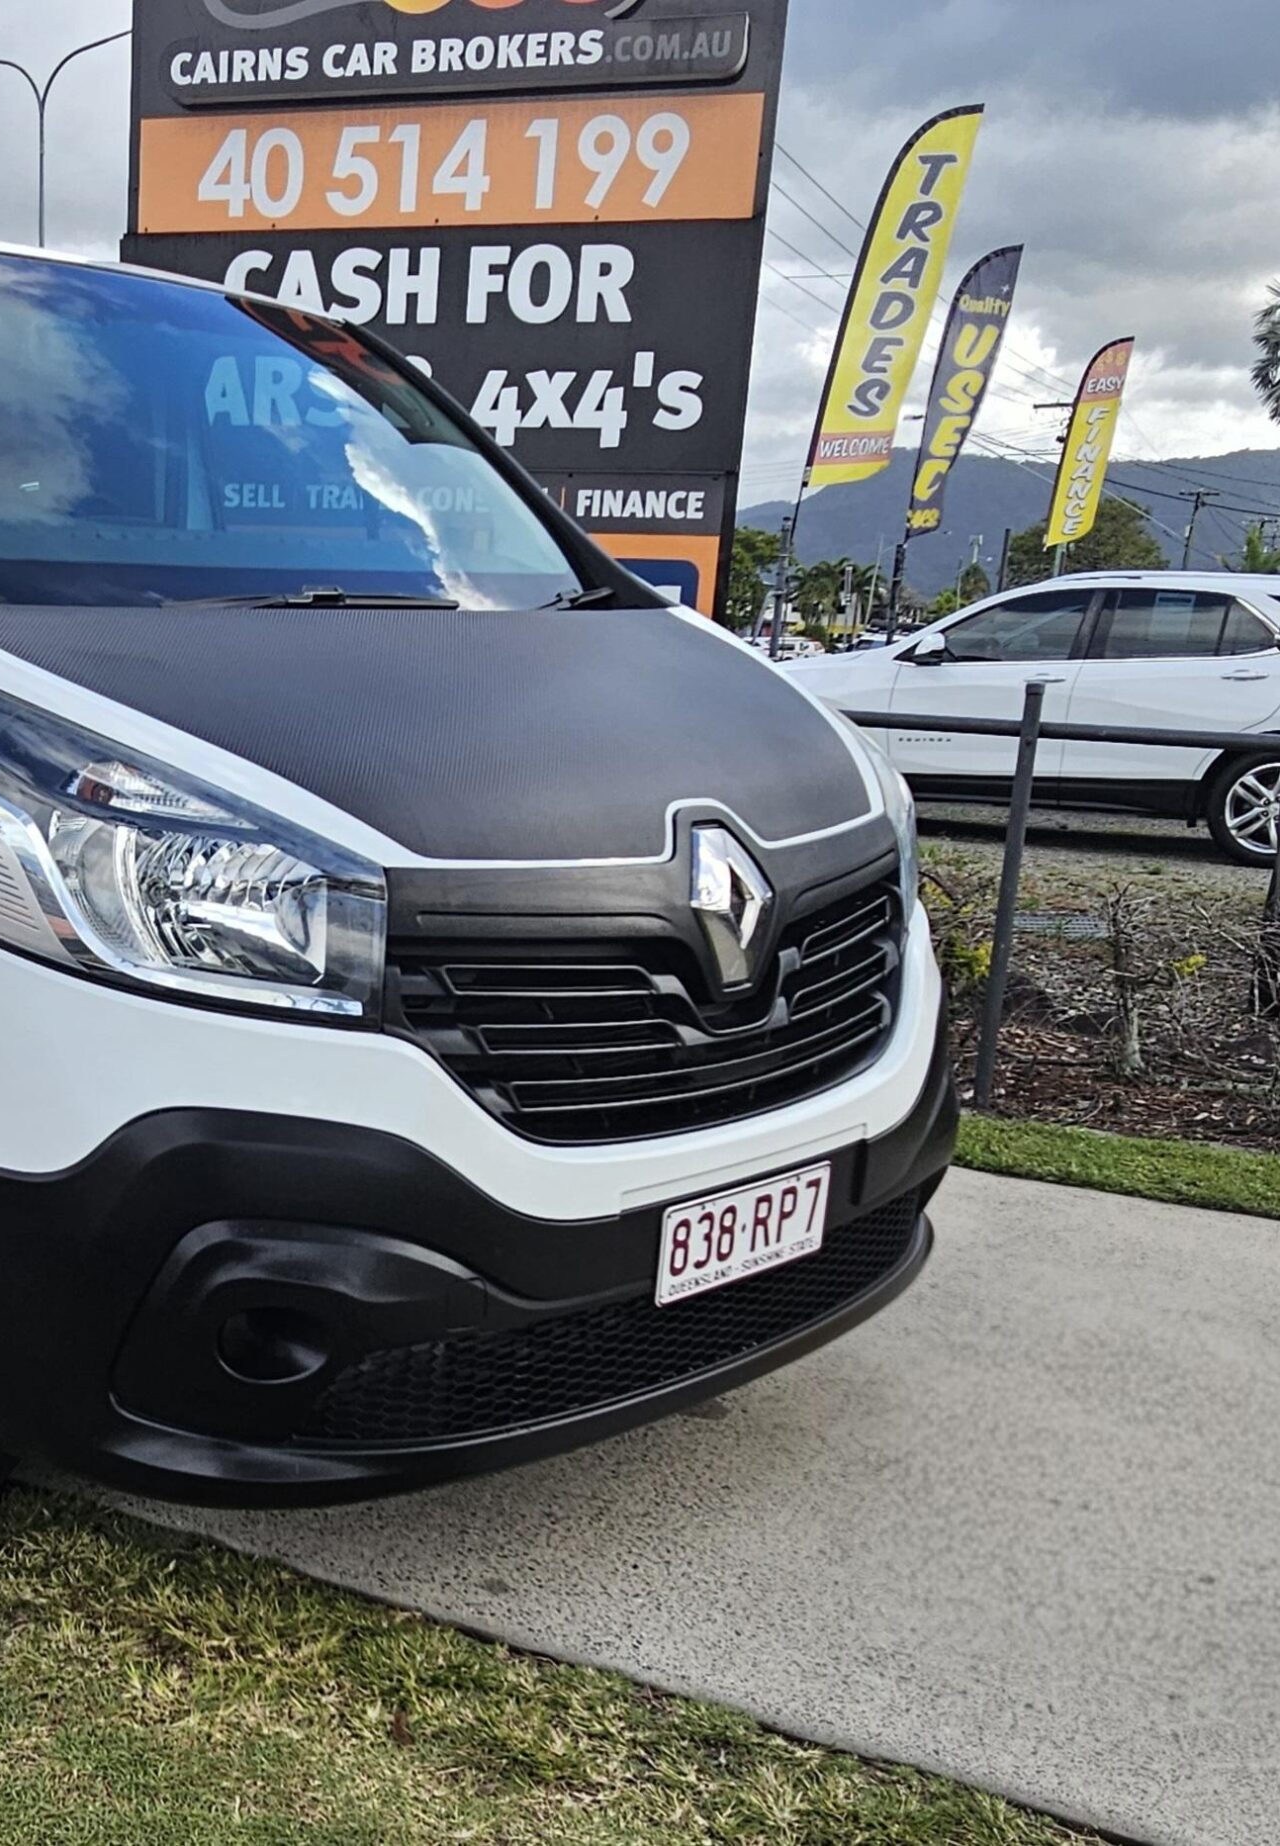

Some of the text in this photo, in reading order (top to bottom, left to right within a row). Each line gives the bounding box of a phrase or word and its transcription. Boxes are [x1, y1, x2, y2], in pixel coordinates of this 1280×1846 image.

[169, 46, 310, 86] CAIRNS
[322, 42, 398, 79] CAR
[197, 111, 691, 218] 40 514 199
[223, 243, 635, 326] CASH FOR
[847, 153, 959, 419] TRADES
[959, 294, 1011, 317] Quality
[1087, 376, 1126, 393] EASY
[820, 436, 891, 458] WELCOME
[1062, 406, 1110, 535] FINANCE
[223, 482, 286, 509] SELL
[576, 489, 705, 520] FINANCE
